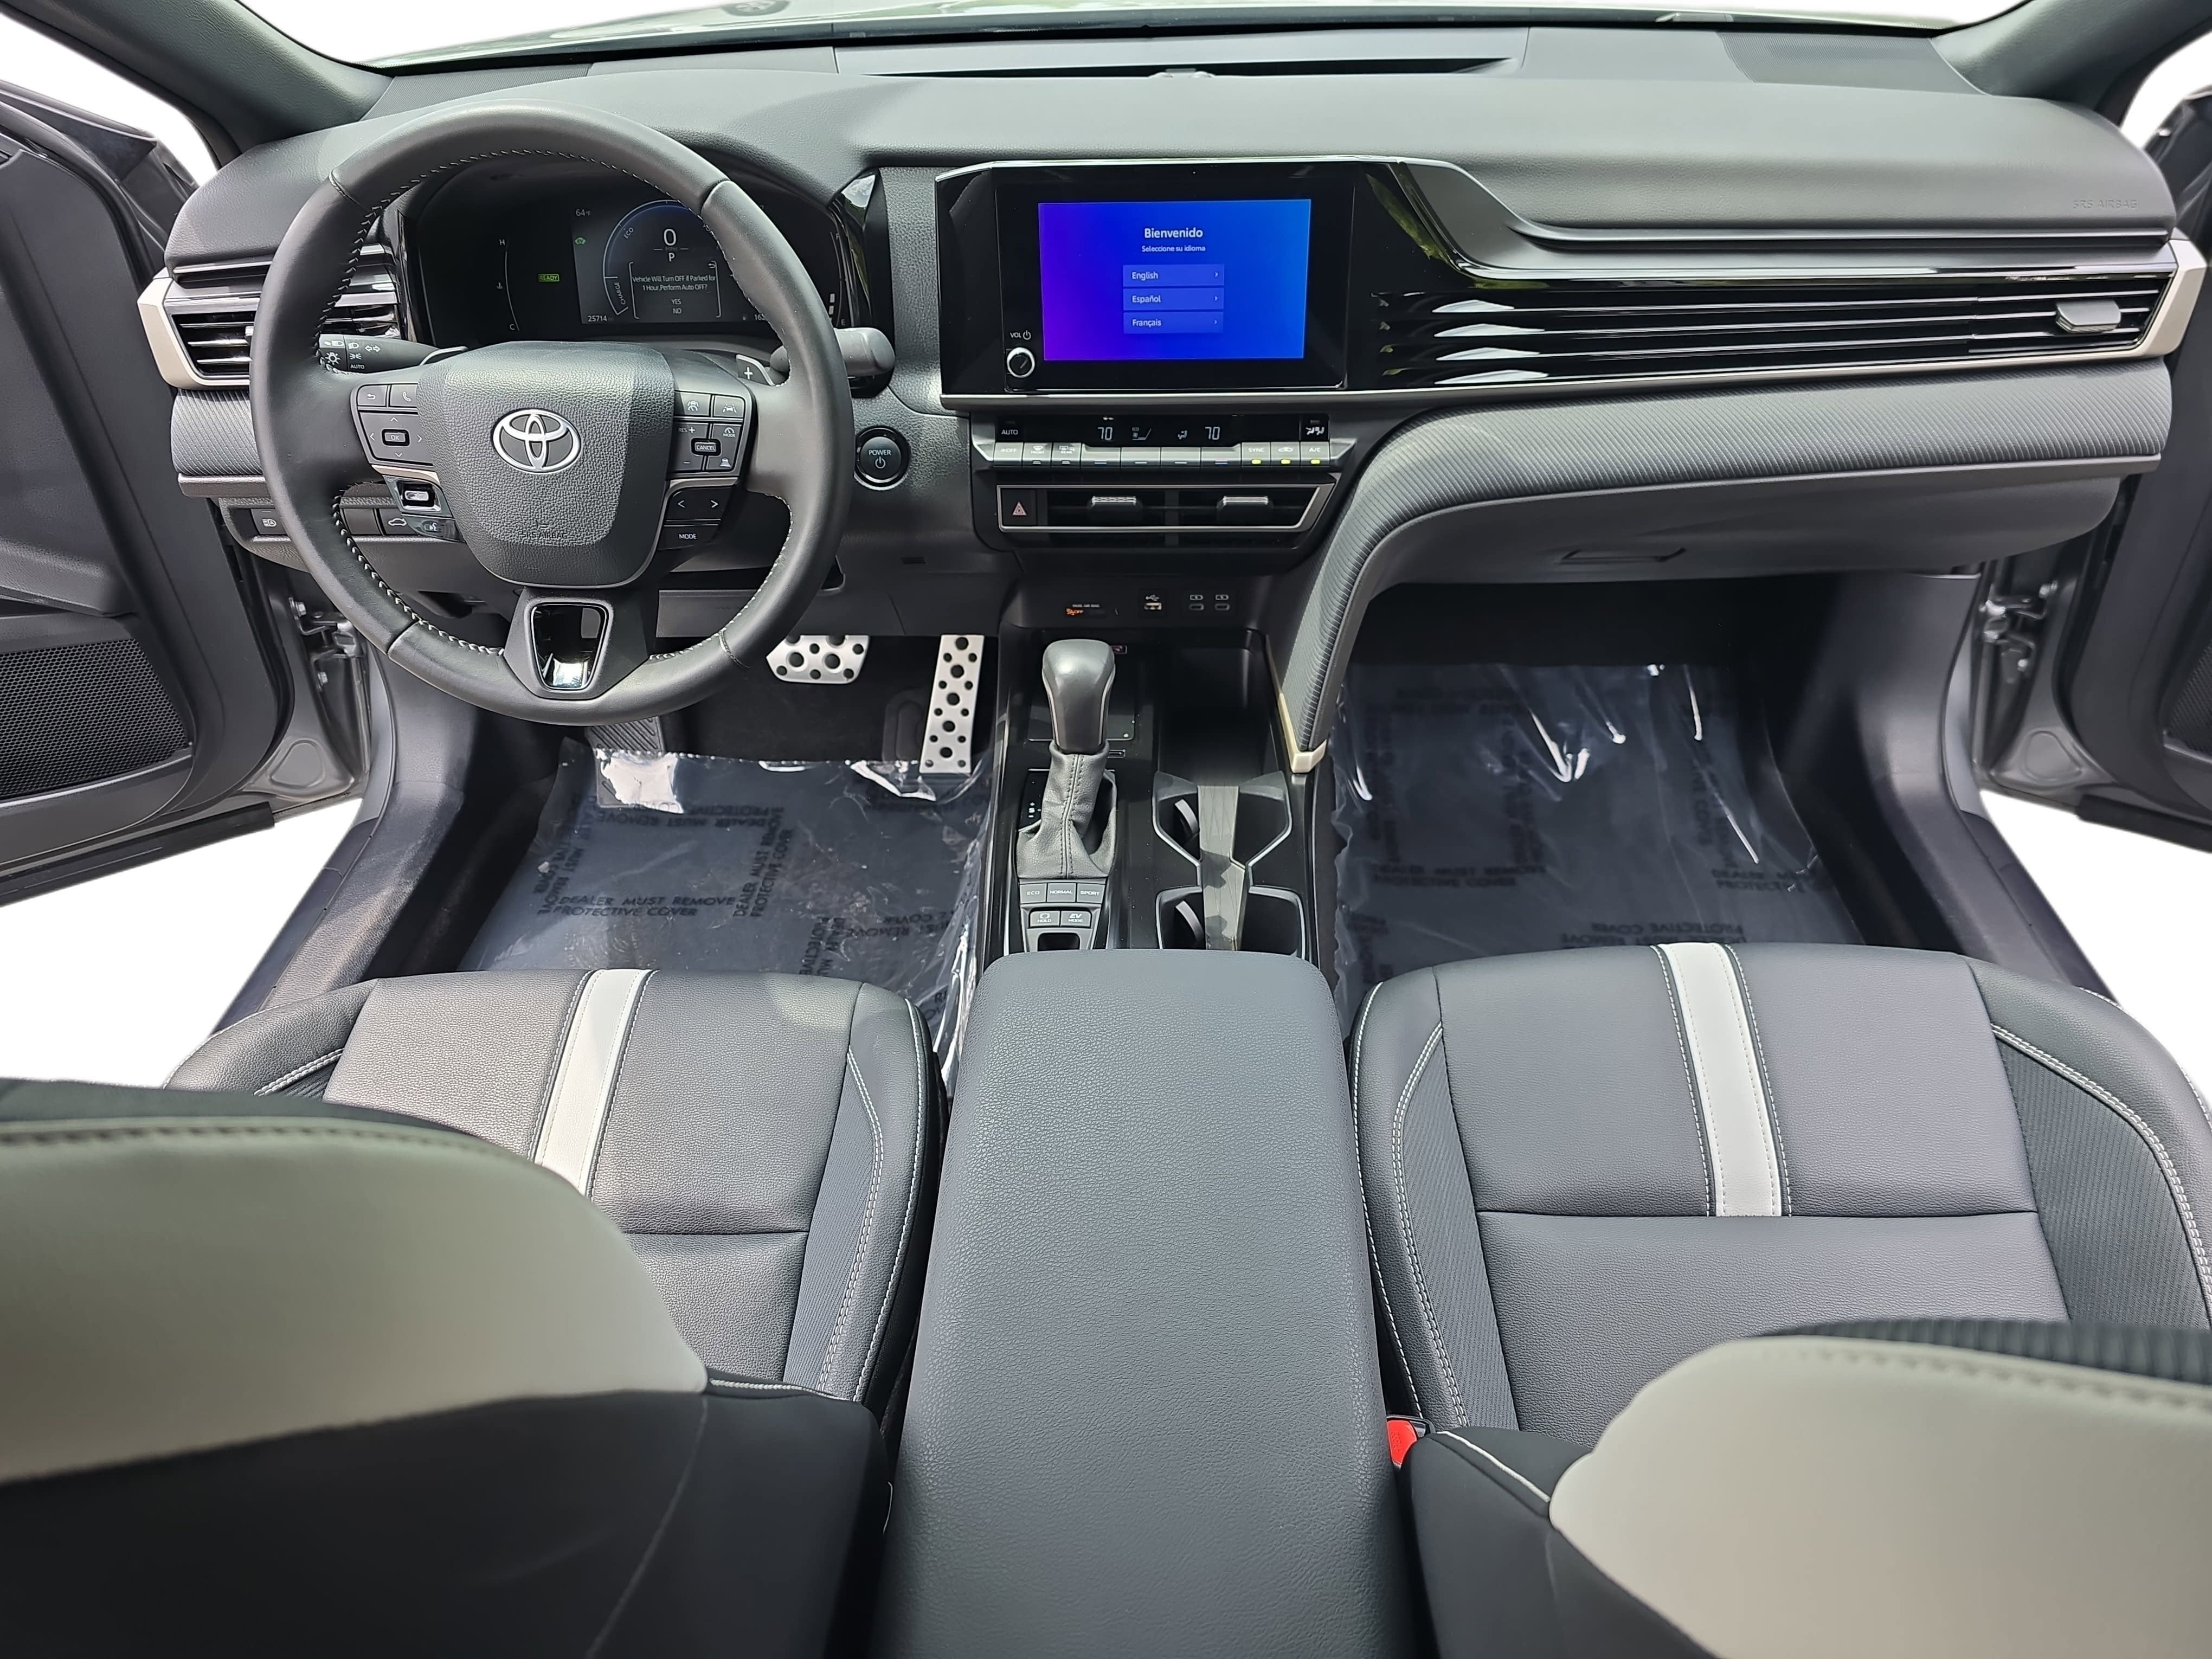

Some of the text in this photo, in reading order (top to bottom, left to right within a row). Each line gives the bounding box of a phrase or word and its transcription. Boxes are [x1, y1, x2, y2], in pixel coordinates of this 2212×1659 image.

[2073, 199, 2137, 209] SRS AIRBAG
[623, 227, 634, 239] ECO
[663, 228, 677, 246] 0
[1144, 227, 1204, 239] Bienvenido
[668, 252, 676, 262] P
[1131, 271, 1159, 281] English
[614, 282, 626, 305] CHARGE
[1131, 294, 1161, 304] Español
[1132, 319, 1162, 327] Français
[1097, 427, 1113, 440] 70
[1205, 426, 1220, 440] 70
[538, 531, 568, 539] AIRBAG
[597, 811, 659, 827] REMOVE
[666, 818, 708, 828] MUST
[1435, 865, 1476, 876] MUST
[732, 882, 758, 917] DEALER
[749, 850, 769, 878] MUST
[1465, 876, 1517, 887] COVER
[749, 862, 782, 917] PROTECTIVE
[559, 896, 736, 906] DEALER MUST REMOVE
[553, 906, 699, 917] PROTECTIVE COVER
[884, 914, 933, 925] COVER
[847, 925, 910, 937] REMOVE
[1591, 922, 1744, 935] PROTECTIVE COVER
[799, 916, 829, 975] PROTECTIVE
